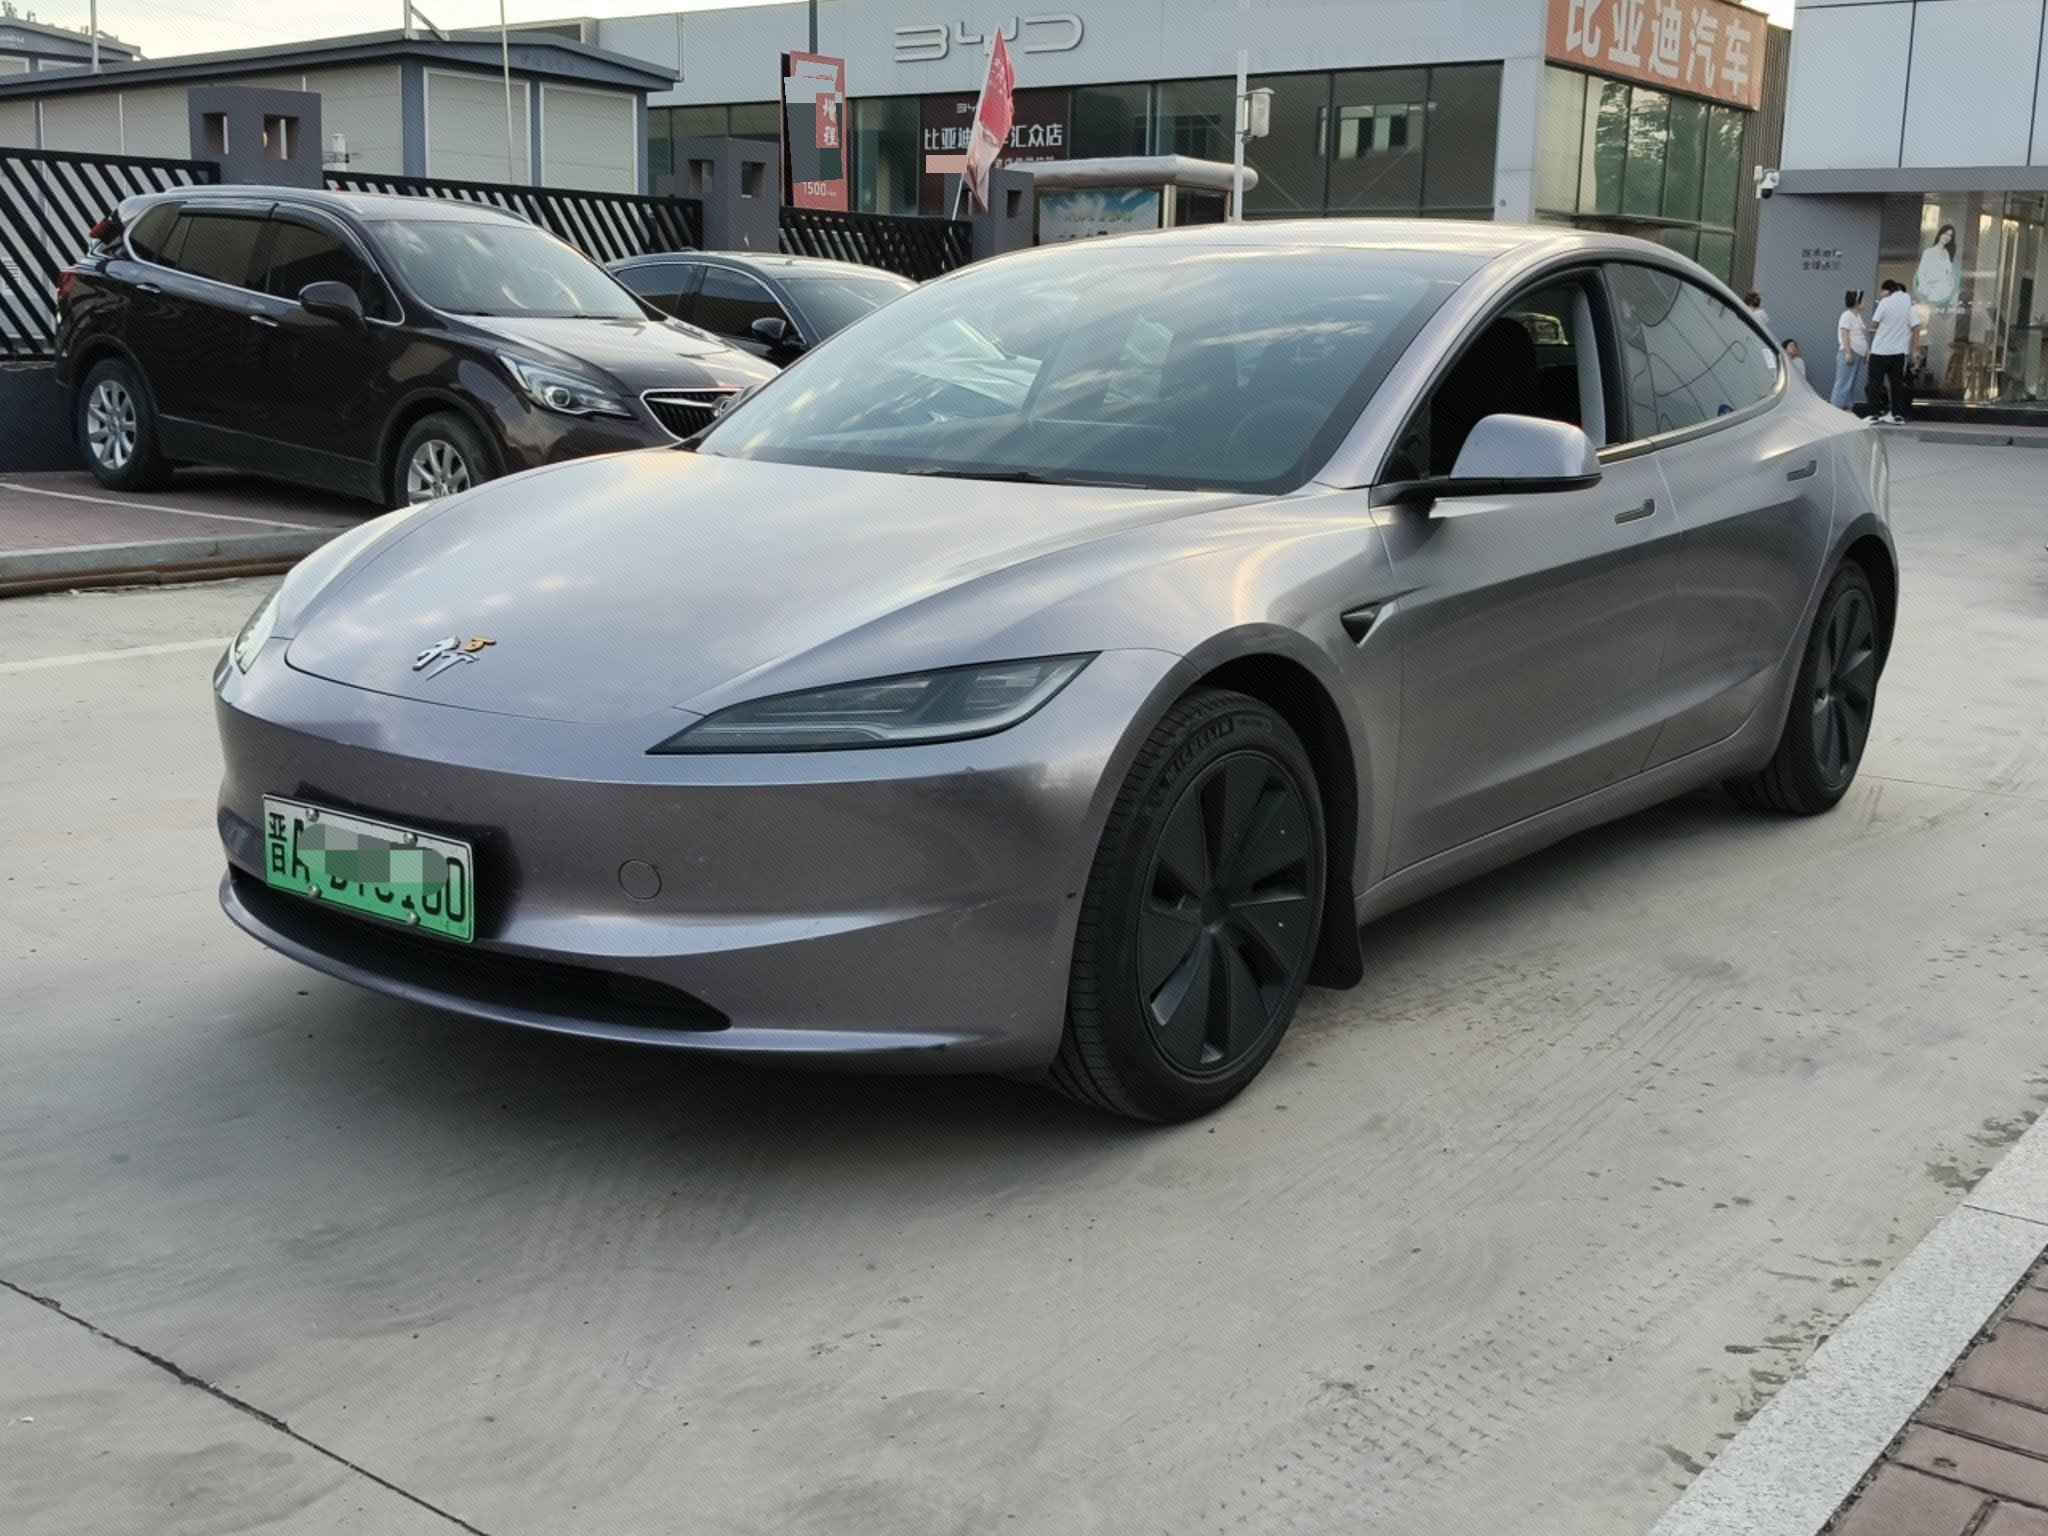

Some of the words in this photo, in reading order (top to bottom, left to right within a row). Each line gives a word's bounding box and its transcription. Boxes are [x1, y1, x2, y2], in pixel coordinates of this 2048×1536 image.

[894, 13, 1084, 62] BYD
[1565, 0, 1750, 95] 比亚迪汽车
